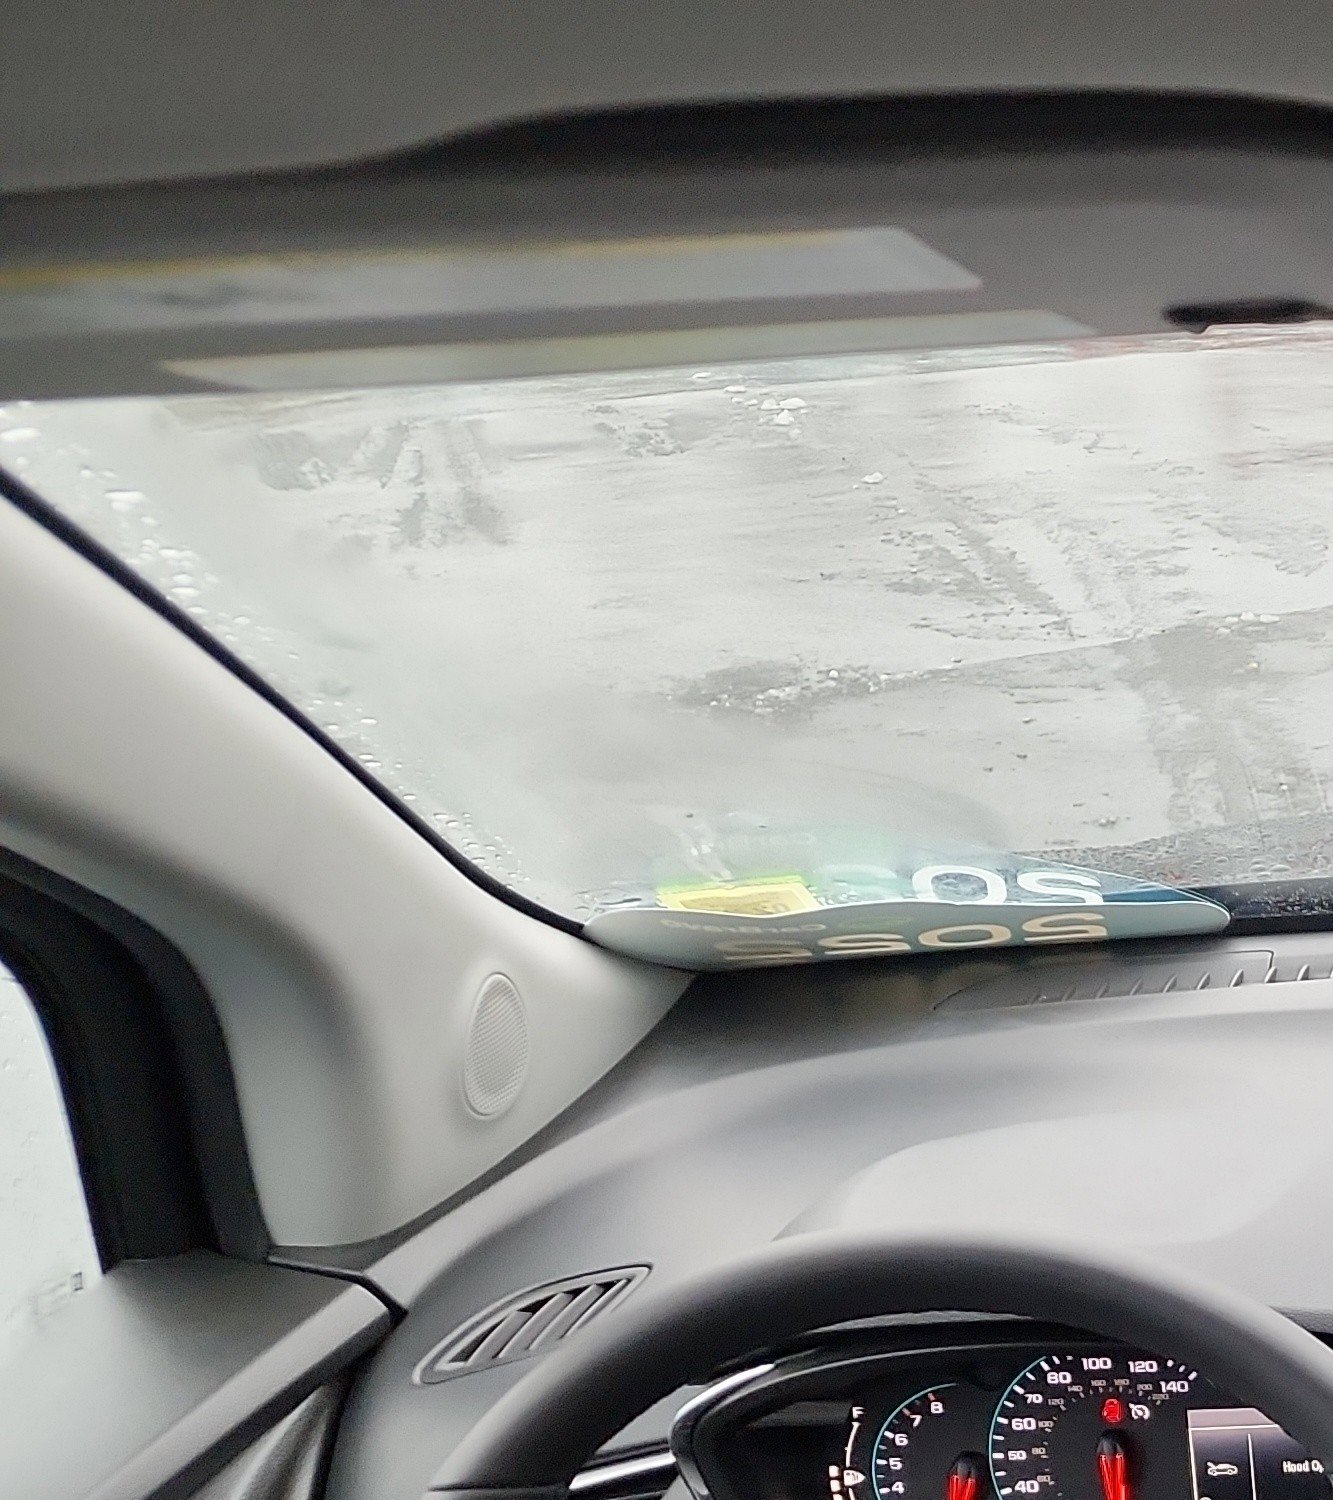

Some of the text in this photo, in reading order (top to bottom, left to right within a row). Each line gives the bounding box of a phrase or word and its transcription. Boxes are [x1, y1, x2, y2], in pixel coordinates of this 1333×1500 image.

[1081, 1358, 1112, 1370] 100
[1128, 1360, 1158, 1373] 120
[1046, 1372, 1072, 1384] 80
[1160, 1381, 1189, 1393] 140
[1024, 1394, 1043, 1404] 70
[852, 1406, 865, 1419] F
[930, 1402, 944, 1414] 8
[910, 1415, 922, 1427] 7
[1011, 1417, 1036, 1430] 60
[894, 1433, 909, 1446] 6
[1007, 1450, 1027, 1461] 50
[888, 1457, 903, 1470] 5
[1282, 1460, 1310, 1473] Hood
[891, 1481, 905, 1494] 4
[1014, 1480, 1039, 1493] 40
